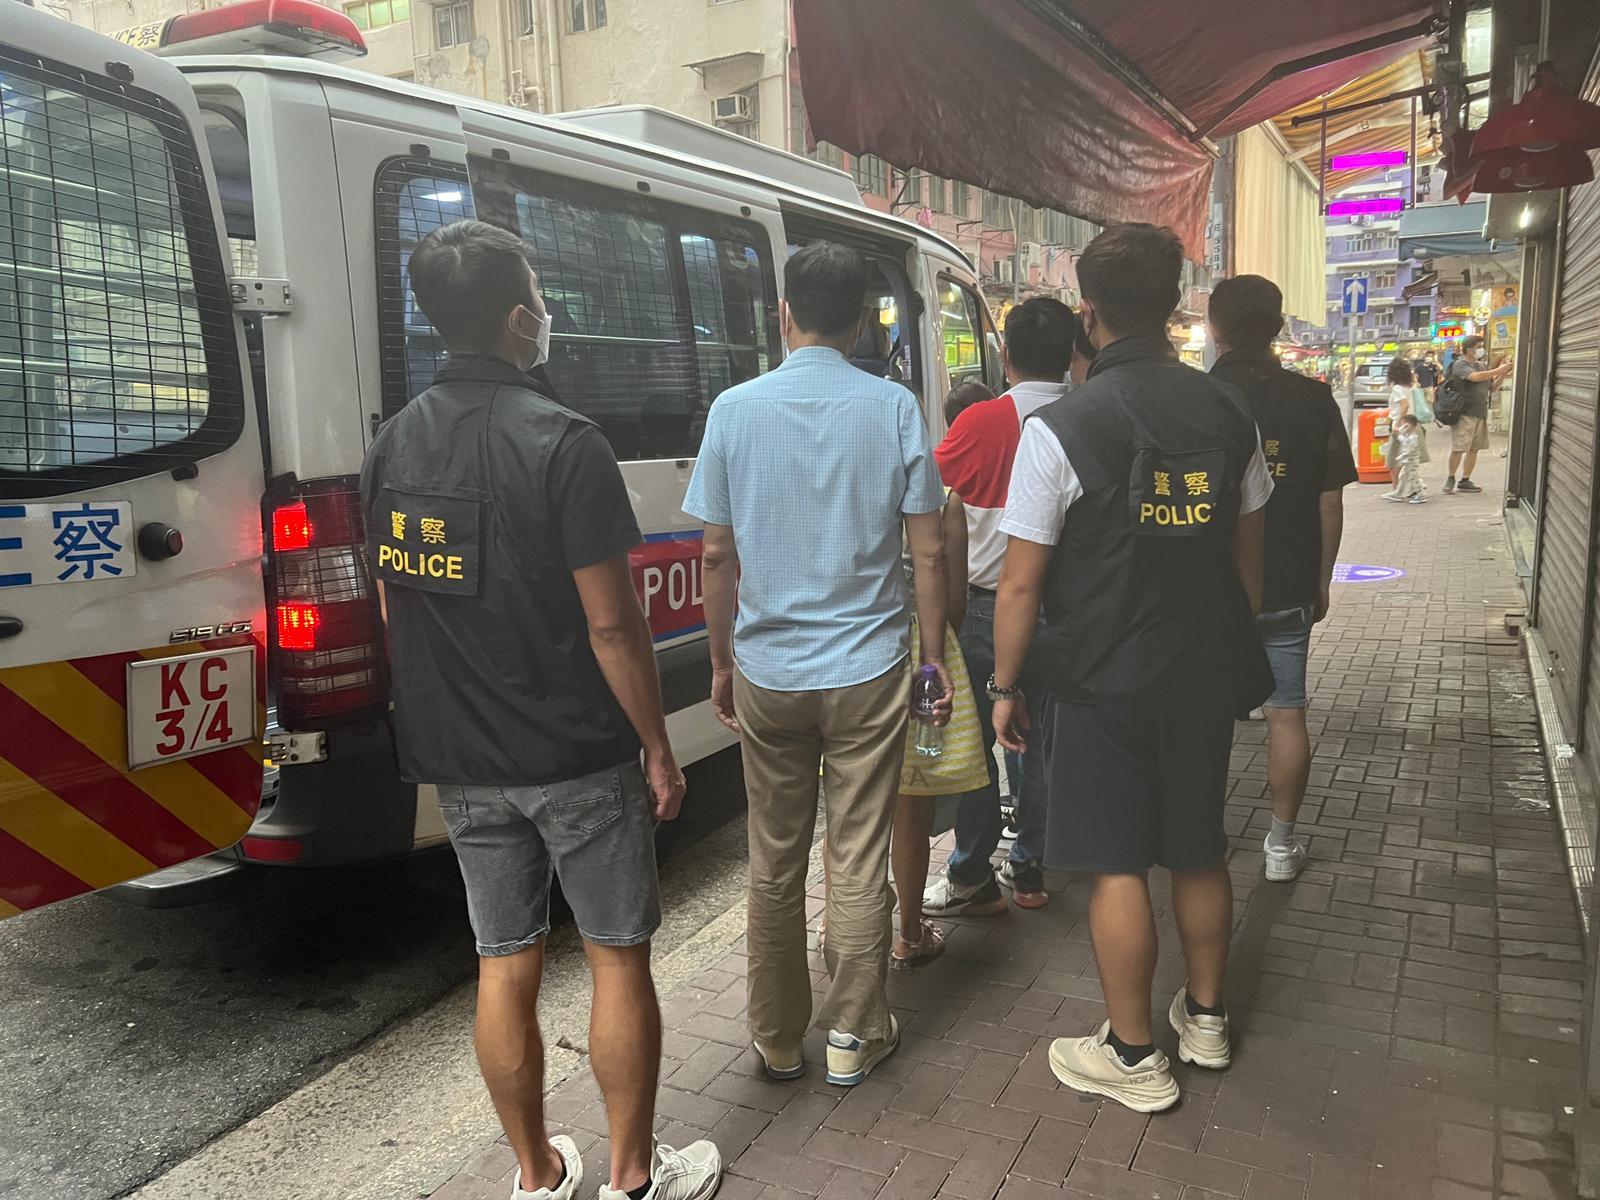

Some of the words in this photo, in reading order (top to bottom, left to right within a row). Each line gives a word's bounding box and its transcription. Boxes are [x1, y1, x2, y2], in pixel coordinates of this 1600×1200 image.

[1153, 471, 1211, 496] 警察
[391, 510, 447, 544] 警察
[1139, 502, 1217, 526] POLIC
[378, 544, 464, 580] POLICE
[160, 656, 229, 710] KC
[155, 699, 233, 756] 3/4
